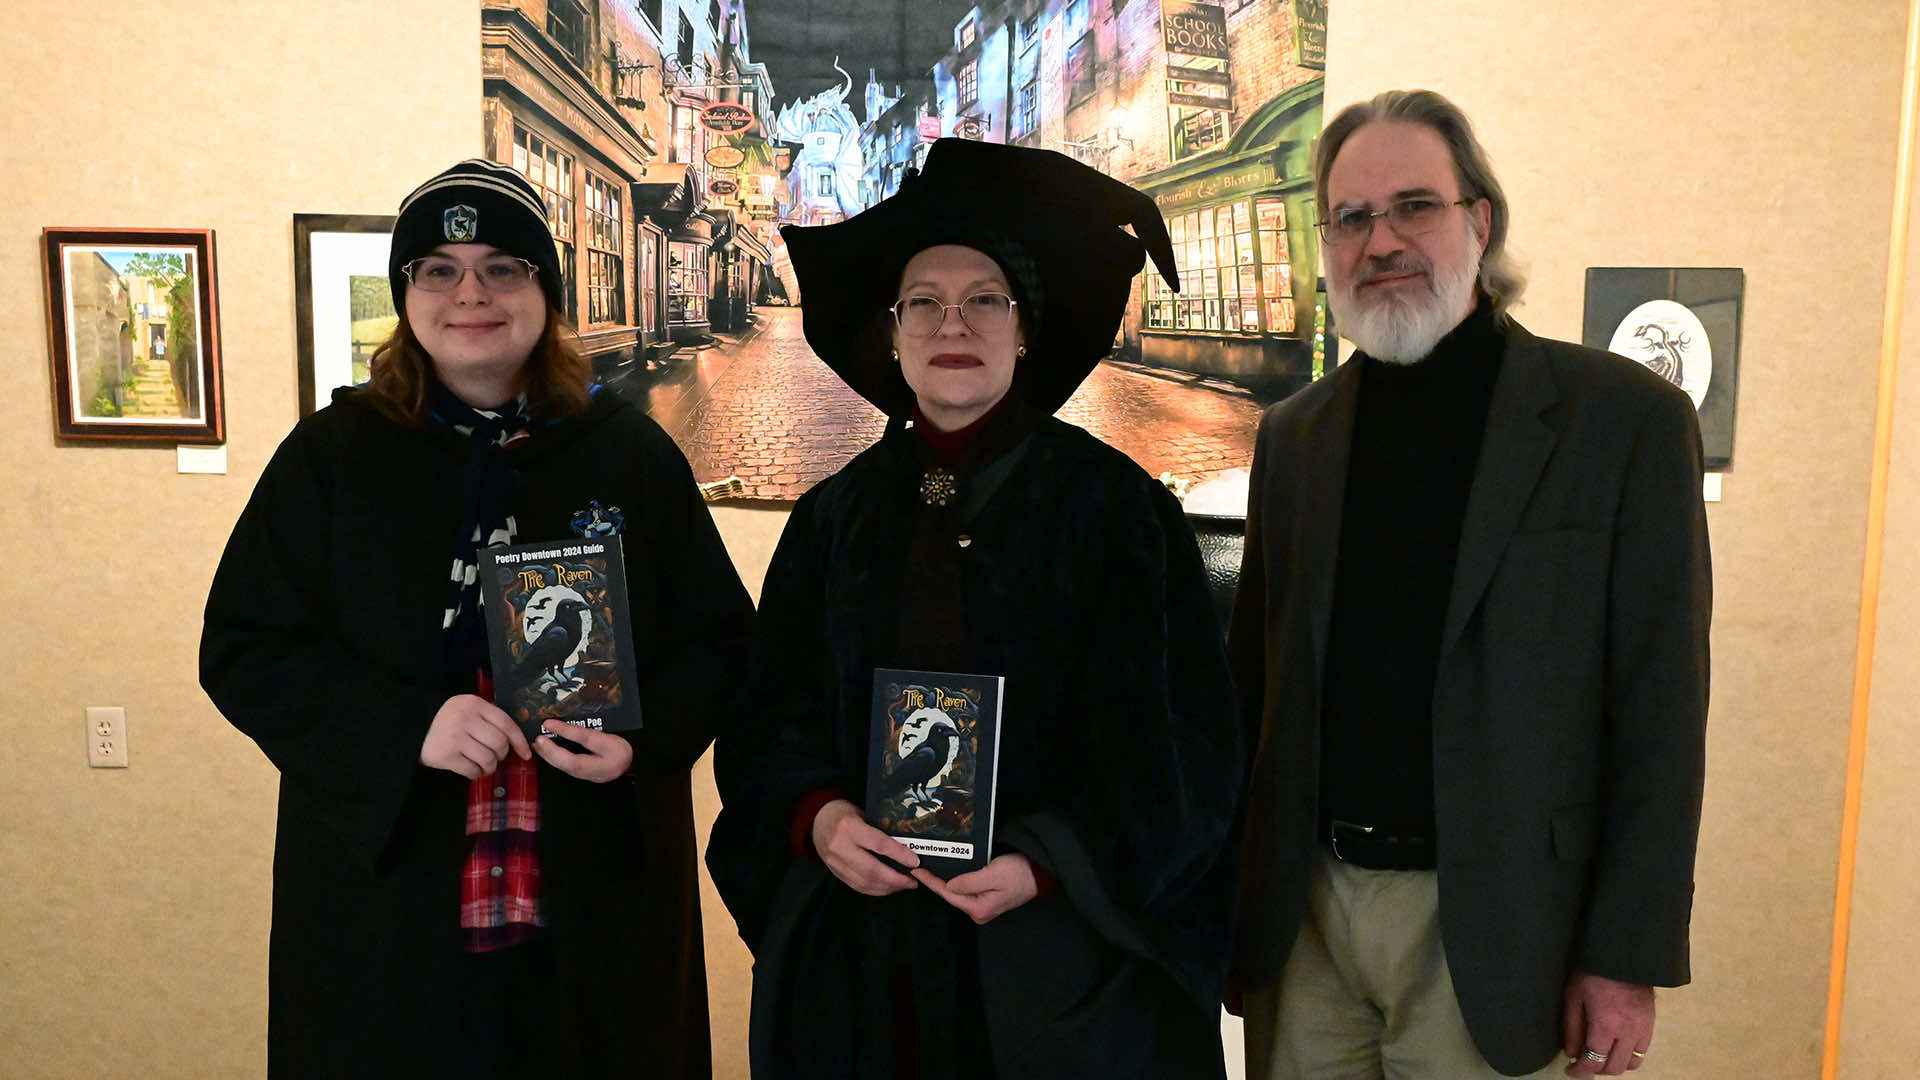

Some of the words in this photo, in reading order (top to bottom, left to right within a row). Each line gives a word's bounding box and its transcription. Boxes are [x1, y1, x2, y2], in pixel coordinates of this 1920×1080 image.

[1165, 15, 1225, 35] SCHOOL
[1166, 28, 1227, 50] BOOKS
[1156, 188, 1192, 205] Flourish
[495, 554, 520, 564] Poetry
[522, 549, 562, 561] Downtown
[563, 546, 582, 557] 2024
[583, 543, 604, 555] Guide
[518, 570, 545, 592] The
[553, 563, 593, 588] Raven
[902, 689, 925, 709] The
[934, 687, 967, 712] Raven
[587, 718, 602, 728] Poe
[909, 843, 949, 853] Downtown
[951, 846, 970, 855] 2024
